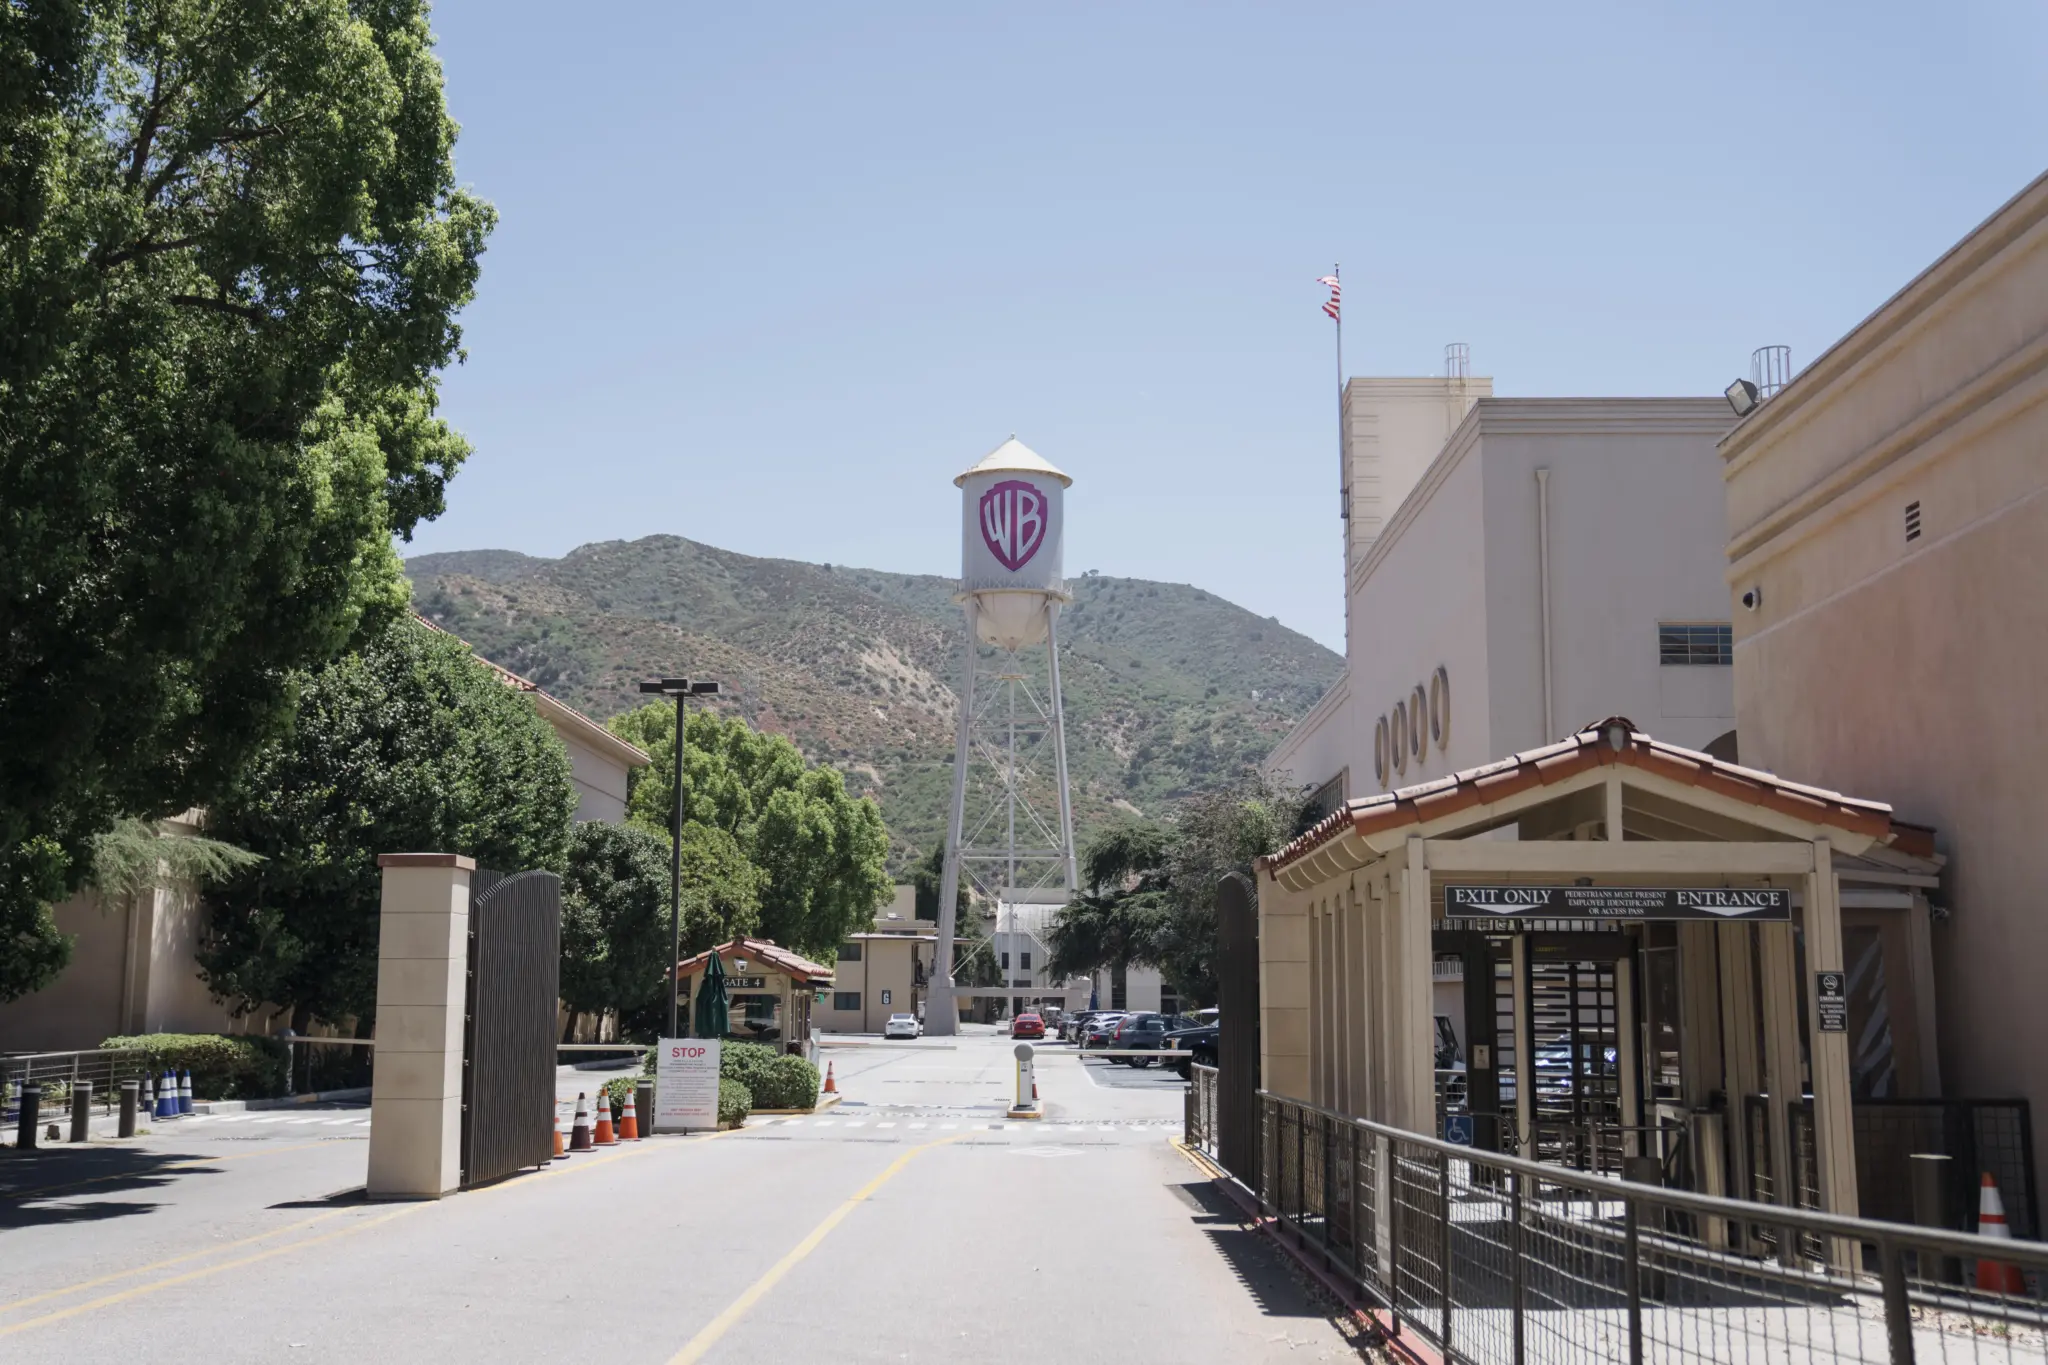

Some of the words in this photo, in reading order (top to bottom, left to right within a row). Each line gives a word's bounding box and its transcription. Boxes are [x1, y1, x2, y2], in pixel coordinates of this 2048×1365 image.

[984, 490, 1041, 561] WB
[1455, 889, 1499, 903] EXIT
[1504, 889, 1552, 904] ONLY
[1565, 890, 1612, 898] PEDESTRIANS
[1635, 891, 1667, 899] PRESENT
[1676, 891, 1780, 906] ENTRANCE
[1607, 899, 1664, 907] IDENTIFICATION
[722, 978, 749, 987] GATE
[754, 978, 760, 987] 4
[672, 1047, 706, 1058] STOP
